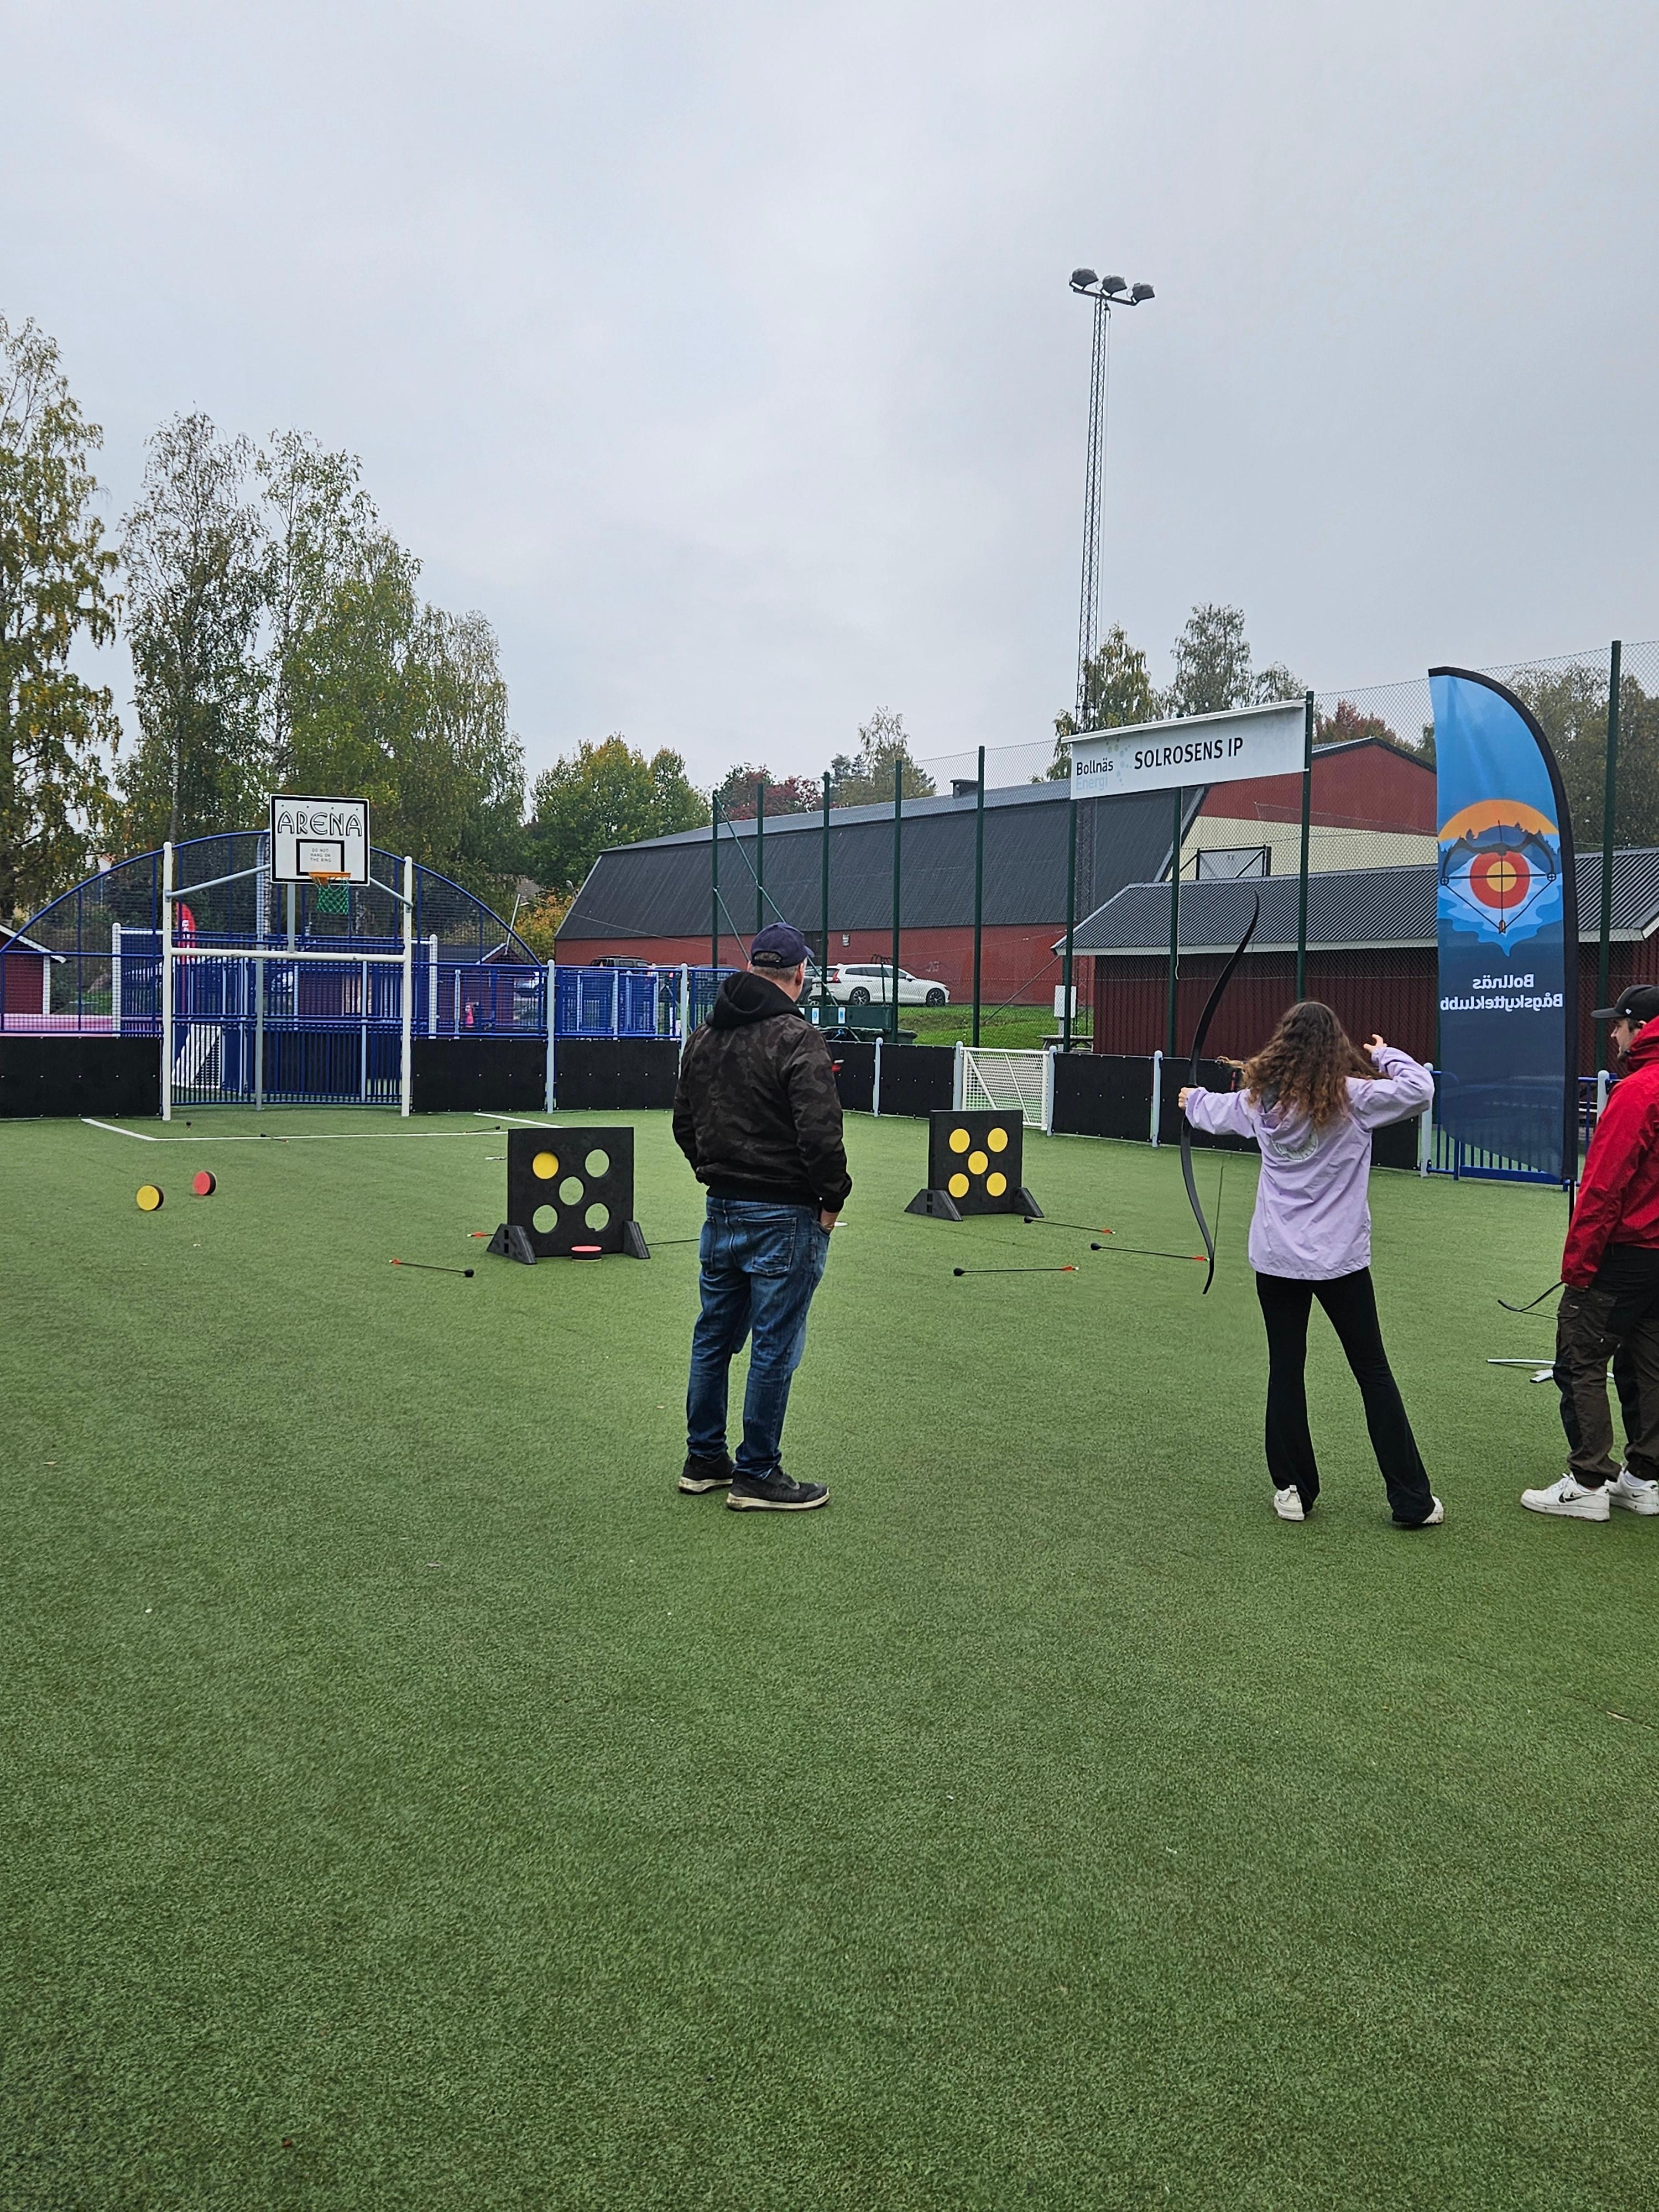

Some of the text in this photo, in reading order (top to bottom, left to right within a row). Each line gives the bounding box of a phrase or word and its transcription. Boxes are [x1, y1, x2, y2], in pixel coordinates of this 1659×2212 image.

[1134, 737, 1243, 770] SOLROSENS IP
[1076, 758, 1114, 775] Bollnäs
[1076, 774, 1108, 791] Energi
[278, 811, 362, 837] ARENA
